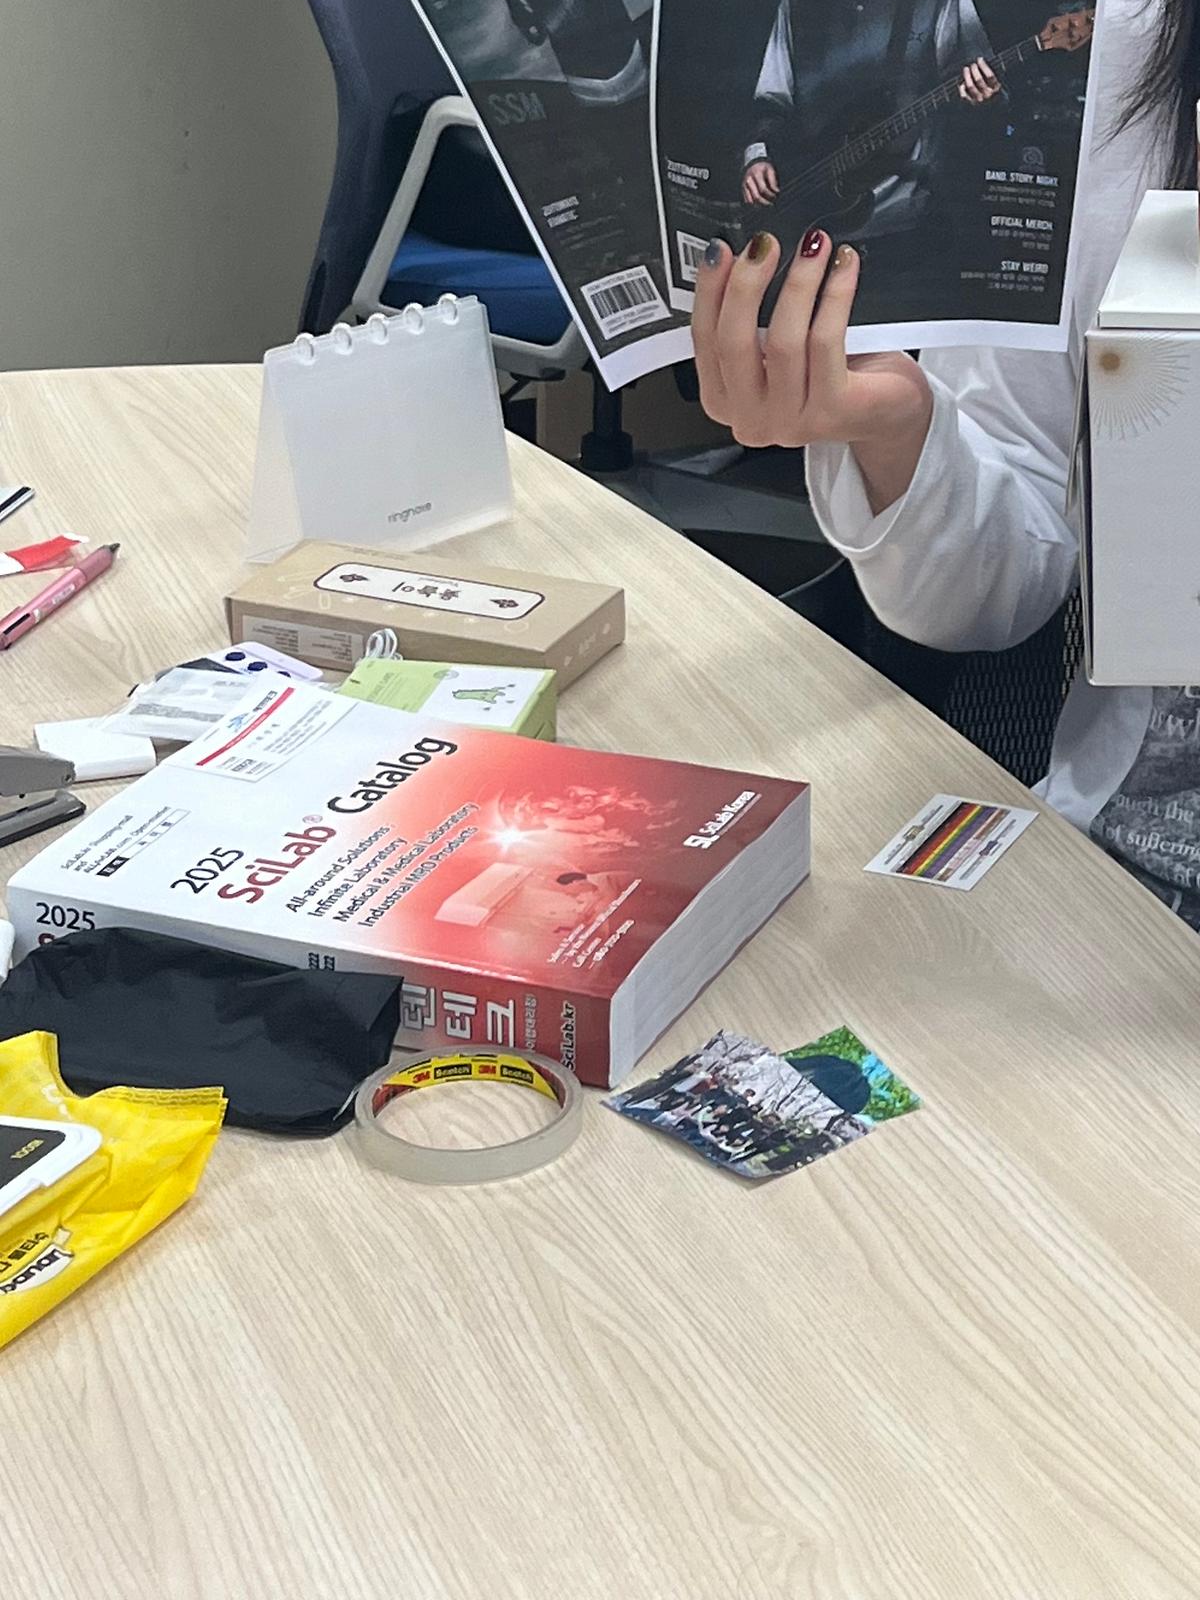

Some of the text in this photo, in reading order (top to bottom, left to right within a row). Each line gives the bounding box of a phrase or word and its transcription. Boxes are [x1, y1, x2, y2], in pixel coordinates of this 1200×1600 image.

[1001, 261, 1049, 274] STAY WEIRD
[327, 736, 458, 813] Catalog
[1163, 800, 1195, 824] the
[170, 846, 246, 895] 2025
[286, 825, 391, 913] All-around Solutions
[308, 837, 408, 917] Infinite Laboratory
[333, 880, 380, 923] Medical
[386, 838, 426, 877] Medical
[421, 802, 480, 847] Laboratory
[358, 825, 480, 928] Industrial MRO Products
[36, 902, 96, 931] 2025
[560, 1001, 577, 1072] SciLab.kr
[479, 1065, 497, 1075] 3M
[502, 1067, 532, 1081] Scotch
